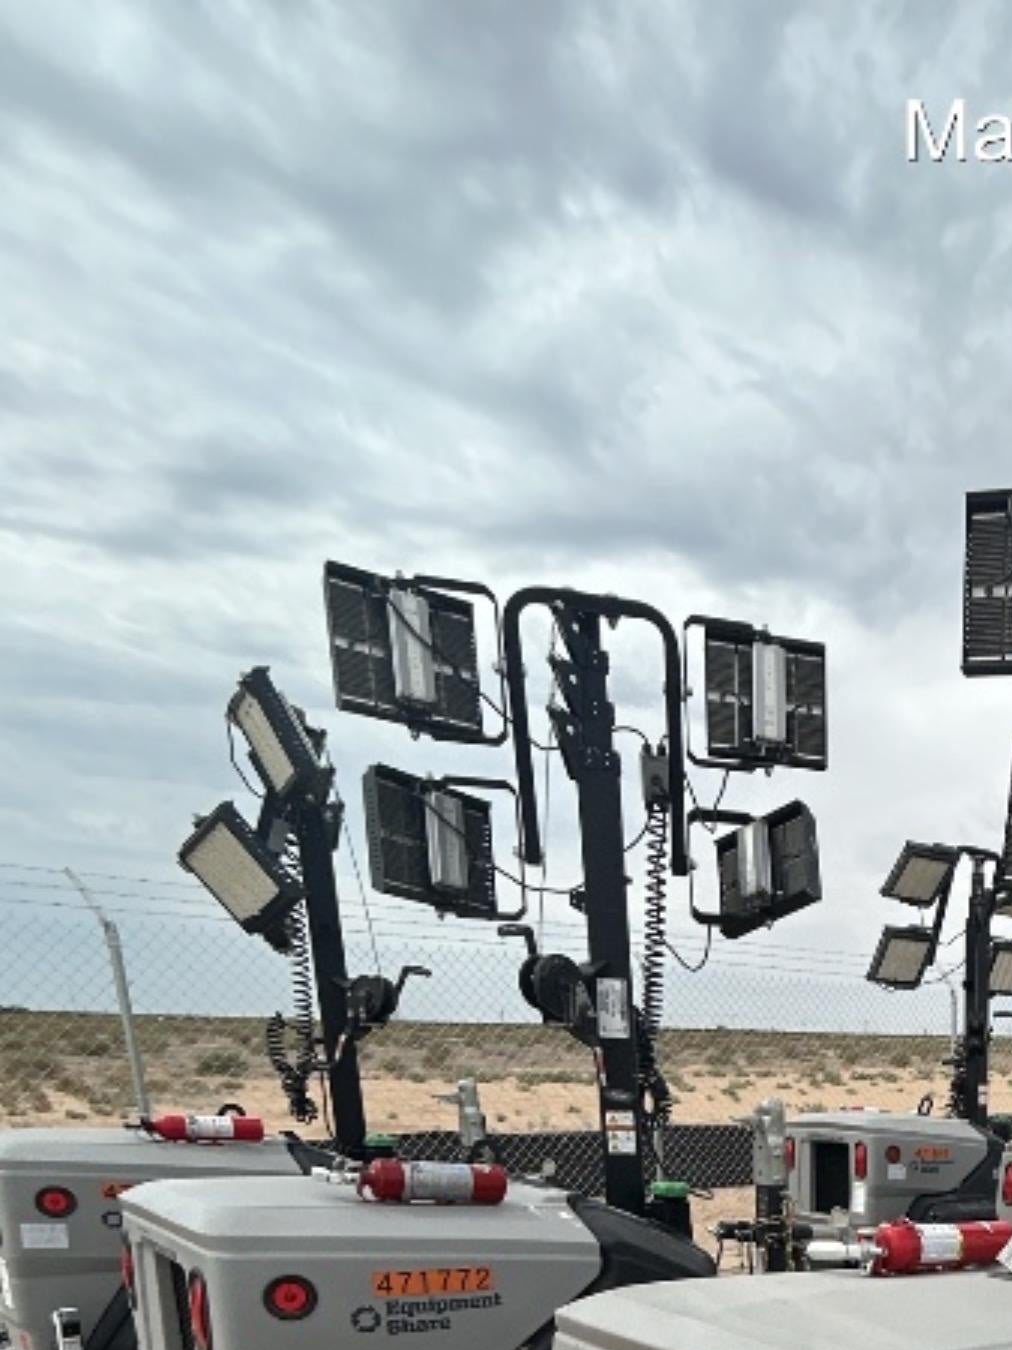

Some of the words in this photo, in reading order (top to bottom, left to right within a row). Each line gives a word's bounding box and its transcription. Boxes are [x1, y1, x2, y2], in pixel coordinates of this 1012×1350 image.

[376, 1268, 491, 1295] 471772
[386, 1292, 503, 1318] Equipment
[386, 1317, 452, 1336] Share
